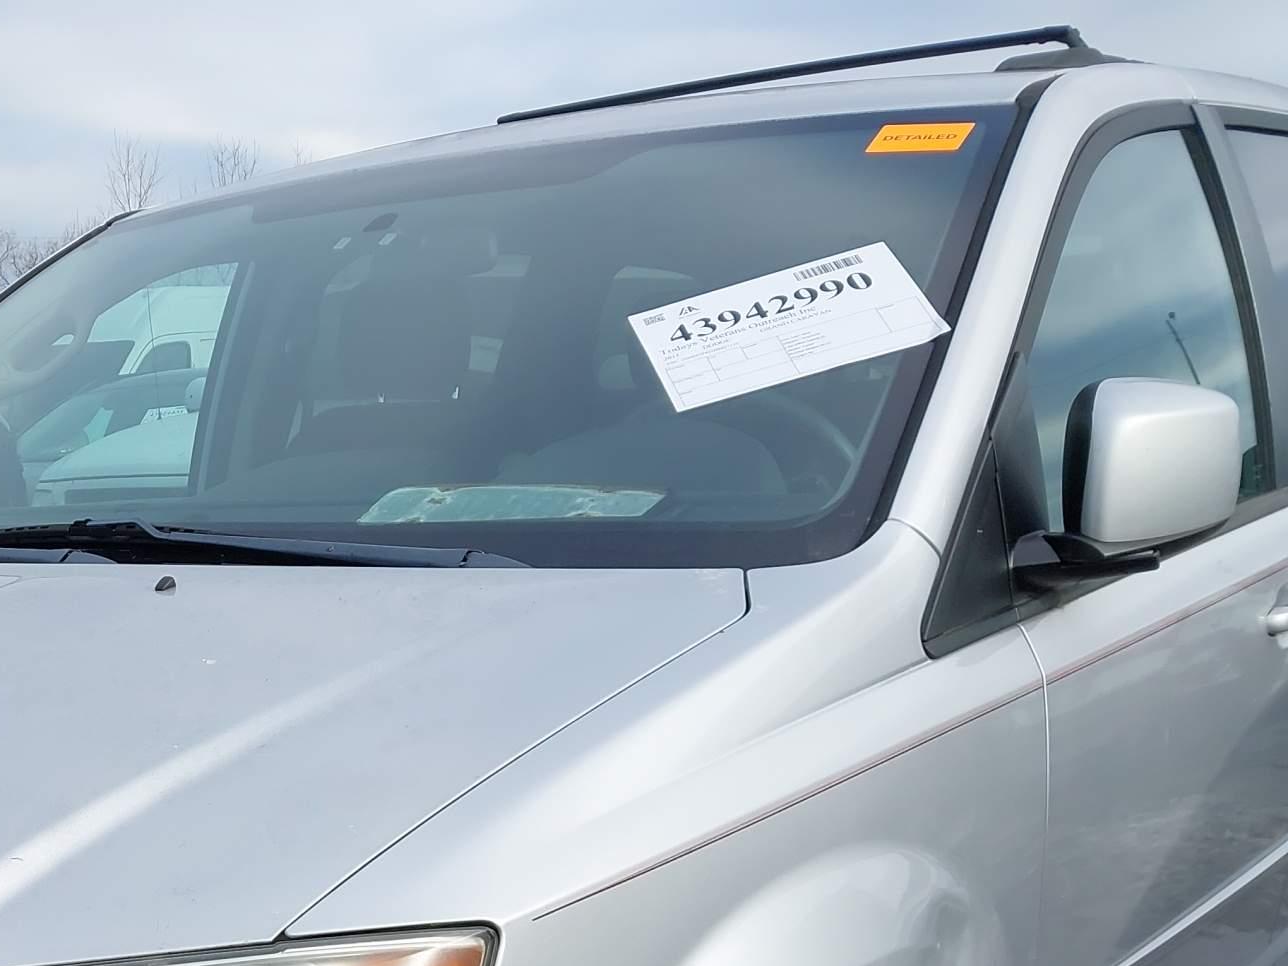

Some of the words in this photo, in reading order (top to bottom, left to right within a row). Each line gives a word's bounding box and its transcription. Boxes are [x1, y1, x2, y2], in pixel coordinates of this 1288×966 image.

[882, 133, 958, 142] DETAILED
[670, 272, 873, 343] 43942990
[699, 326, 746, 343] Veterans
[748, 311, 797, 329] Outreach
[798, 305, 817, 315] Inc
